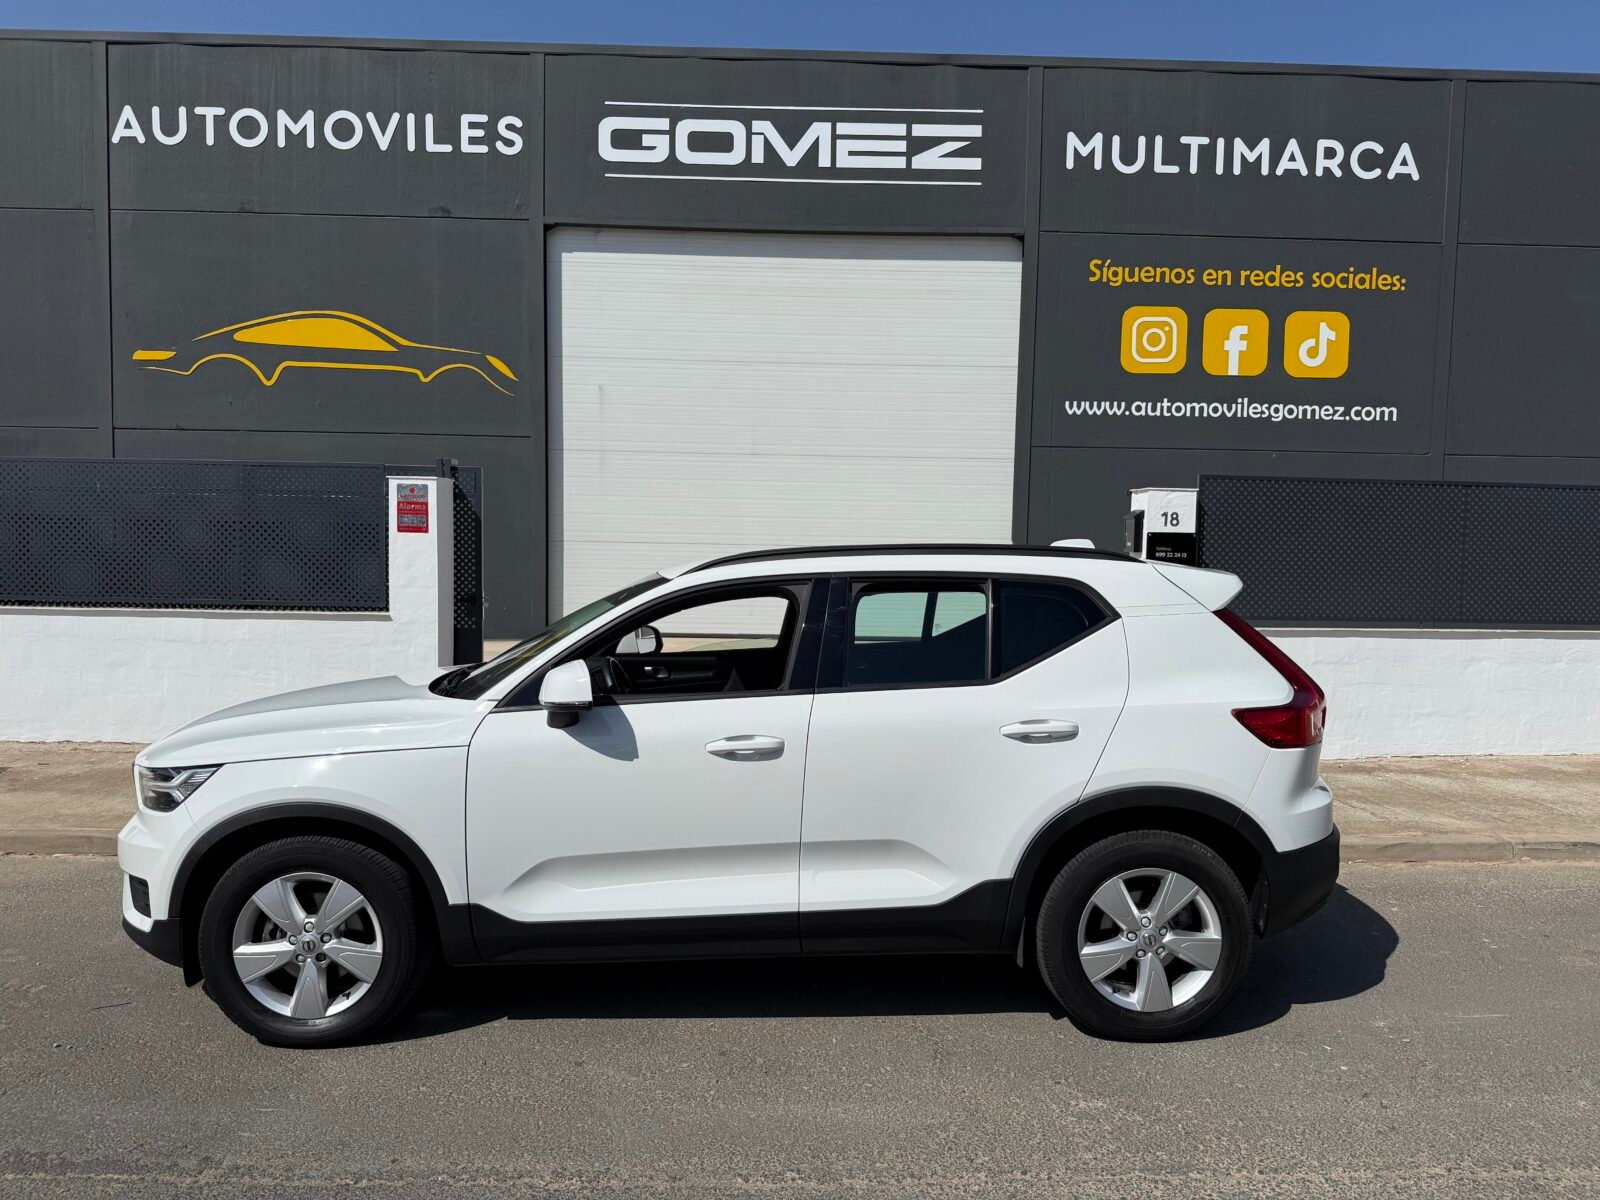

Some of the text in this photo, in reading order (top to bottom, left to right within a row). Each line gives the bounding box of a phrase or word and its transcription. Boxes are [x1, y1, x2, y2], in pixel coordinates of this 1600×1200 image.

[111, 104, 524, 156] AUTOMOVILES
[598, 116, 983, 170] GOMEZ
[1065, 131, 1420, 182] MULTIMARCA
[1089, 258, 1407, 292] Síguenos en redes sociales:
[1065, 397, 1398, 422] www.automovilesgomez.com
[1161, 511, 1180, 527] 18
